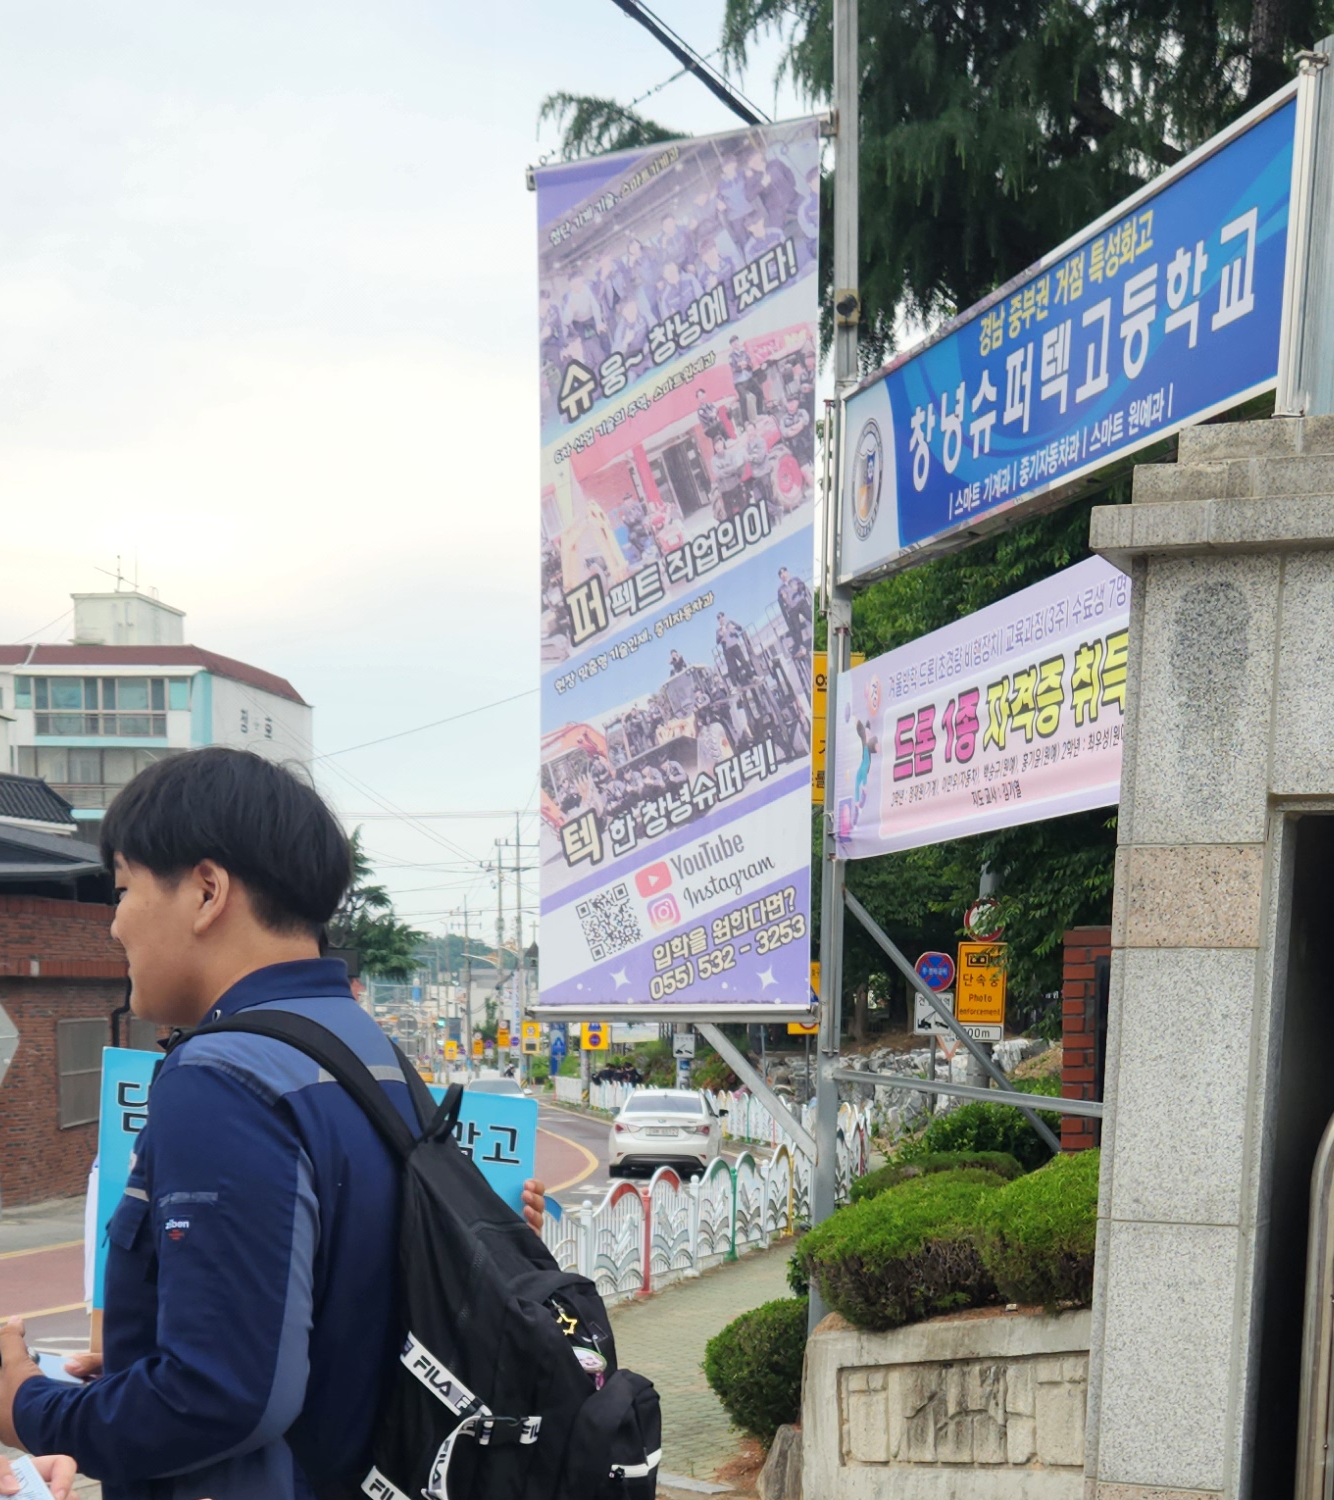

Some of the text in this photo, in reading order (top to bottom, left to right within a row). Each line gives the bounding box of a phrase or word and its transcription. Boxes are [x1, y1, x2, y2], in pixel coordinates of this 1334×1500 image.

[648, 282, 729, 366] 창녕에
[732, 236, 798, 313] 떴다!
[979, 210, 1154, 356] 경남 중부권 거점 특성화고
[909, 206, 1258, 492] 창녕슈퍼텍고등학교
[573, 428, 595, 454] 산업
[595, 408, 626, 437] 기술의
[954, 388, 1164, 515] 스마트 기계과 중기자동차과 스마트 원예과
[666, 500, 771, 584] 직업인이
[1072, 582, 1105, 625] 수료생
[1108, 574, 1127, 609] 7명
[554, 671, 576, 694] 현장
[578, 653, 608, 681] 맞춤형
[654, 590, 714, 638] 중기자동차과
[893, 627, 1130, 782] 드론 1종 자격증 취득
[641, 739, 778, 839] 창녕슈퍼텍!
[670, 834, 745, 880] YouTube
[683, 857, 775, 909] Instagram
[650, 960, 695, 1000] 055)
[697, 944, 736, 980] 532
[755, 913, 807, 955] 3253
[653, 885, 796, 972] 입학을 원한다면?
[959, 1008, 1001, 1016] enforcement
[969, 993, 993, 1002] Photo
[964, 1027, 990, 1038] 00m
[165, 1218, 190, 1230] ziben
[413, 1355, 452, 1398] FILA
[432, 1440, 452, 1484] FILA
